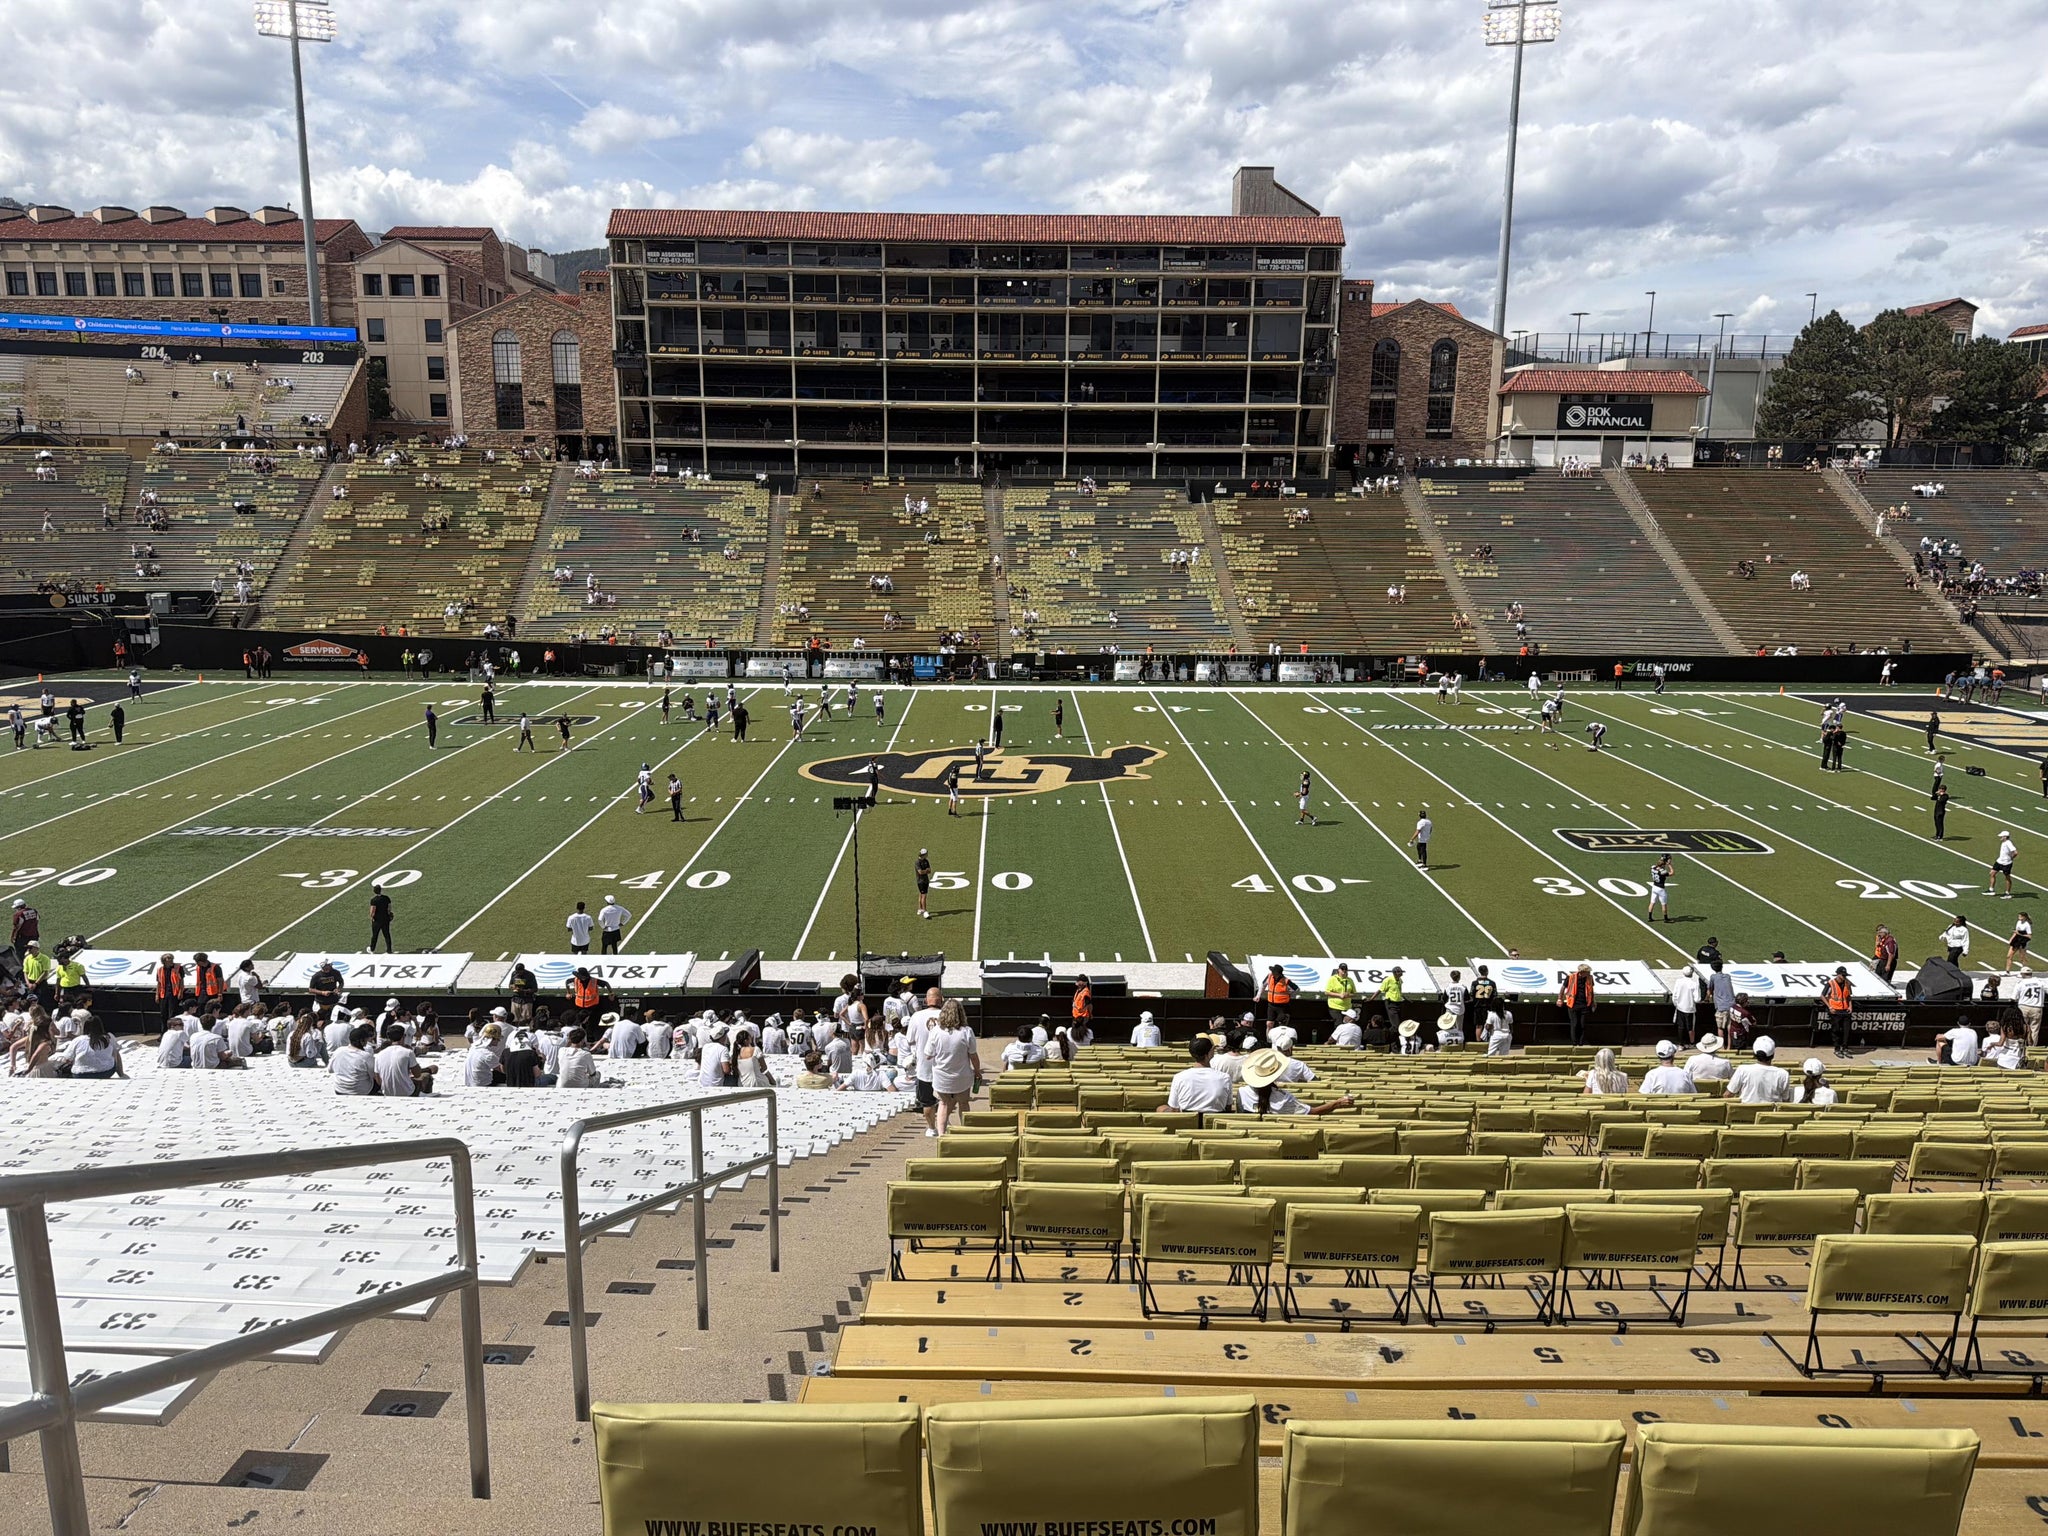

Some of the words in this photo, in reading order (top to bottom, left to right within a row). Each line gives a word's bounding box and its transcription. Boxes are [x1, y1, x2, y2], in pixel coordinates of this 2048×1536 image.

[141, 346, 165, 359] 204
[302, 351, 324, 363] 203
[1587, 407, 1611, 417] BOK
[1587, 417, 1645, 427] FINANCIAL
[68, 594, 99, 604] SUN'S
[102, 593, 116, 603] UP
[1636, 663, 1691, 672] ELEVTIONS
[168, 826, 429, 837] PROGRESSIVE
[0, 867, 117, 886] 20
[301, 869, 422, 888] 30
[619, 870, 731, 889] 40
[928, 871, 1033, 890] 50
[1231, 873, 1338, 893] 40
[1533, 877, 1649, 897] 30
[1835, 879, 1957, 899] 20
[352, 964, 442, 979] AT&T
[588, 965, 668, 979] AT&T
[1557, 971, 1632, 985] A&T
[1450, 992, 1461, 1003] 21
[1475, 985, 1493, 999] 29
[2024, 987, 2041, 999] 45
[1851, 1012, 1907, 1020] SSISTANCE?
[1817, 1021, 1832, 1030] Tex
[1851, 1021, 1905, 1030] 0-812-1769
[790, 1032, 805, 1045] 50
[385, 1187, 409, 1195] 31
[130, 1196, 164, 1205] 29
[221, 1199, 253, 1208] 30
[311, 1202, 338, 1212] 31
[395, 1205, 426, 1215] 32
[486, 1209, 517, 1218] 33
[128, 1217, 165, 1226] 30
[227, 1220, 258, 1230] 31
[904, 1223, 987, 1231] WWW.BUFFSEATS.COM
[324, 1224, 359, 1234] 32
[424, 1227, 454, 1237] 33
[521, 1231, 555, 1240] 34
[1025, 1224, 1109, 1236] WWW.BUFFSEATS.COM
[121, 1243, 156, 1254] 31
[228, 1247, 268, 1259] 32
[1161, 1244, 1257, 1257] WWW.BUFFSEATS.COM
[340, 1251, 380, 1263] 33
[1303, 1251, 1399, 1263] WWW.BUFFSEATS.COM
[1449, 1258, 1545, 1268] WWW.BUFFSEATS.COM
[1582, 1252, 1679, 1264] WWW.BUFFSEATS.COM
[107, 1270, 153, 1284] 32
[951, 1265, 959, 1276] 1
[1060, 1267, 1078, 1280] 2
[1177, 1270, 1196, 1282] 3
[233, 1275, 280, 1289] 33
[1295, 1272, 1313, 1285] 4
[1764, 1274, 1788, 1287] 8
[937, 1291, 946, 1303] 1
[1063, 1292, 1083, 1305] 2
[1835, 1292, 1949, 1305] WWW.BUFFSEATS.COM
[1330, 1298, 1351, 1313] 4
[1464, 1301, 1489, 1315] 5
[1594, 1301, 1620, 1316] 6
[1734, 1303, 1756, 1316] 7
[100, 1313, 156, 1330] 33
[919, 1338, 928, 1353] 1
[1069, 1340, 1091, 1355] 2
[1223, 1344, 1248, 1360] 3
[1379, 1347, 1403, 1363] 4
[1534, 1347, 1563, 1363] 5
[1690, 1348, 1720, 1363] 6
[2000, 1350, 2034, 1367] 8
[1262, 1404, 1290, 1424] 3
[2008, 1417, 2043, 1437] 7
[981, 1519, 1216, 1536] WWW.BUFFSEATS.COM
